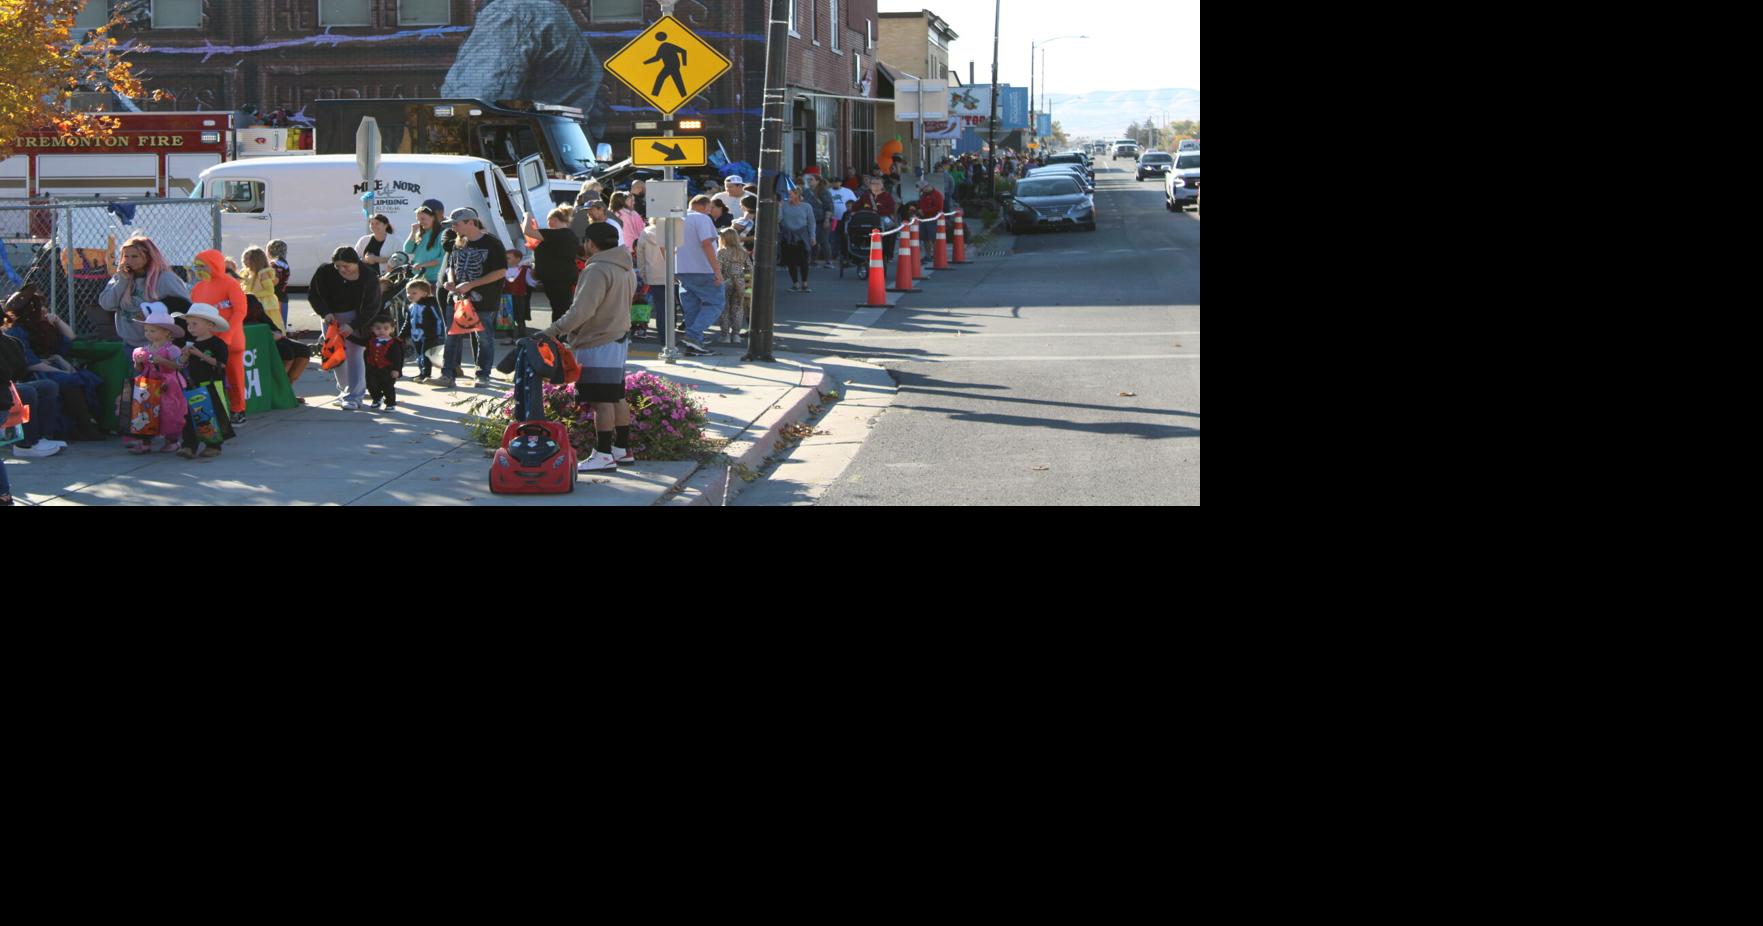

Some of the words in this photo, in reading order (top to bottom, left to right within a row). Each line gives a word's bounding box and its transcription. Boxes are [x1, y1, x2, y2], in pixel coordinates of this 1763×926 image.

[14, 136, 129, 148] TREMONTON
[138, 135, 184, 147] FIRE
[353, 180, 383, 195] MIE
[393, 180, 421, 194] NORR
[243, 349, 257, 367] OF
[244, 368, 262, 400] H
